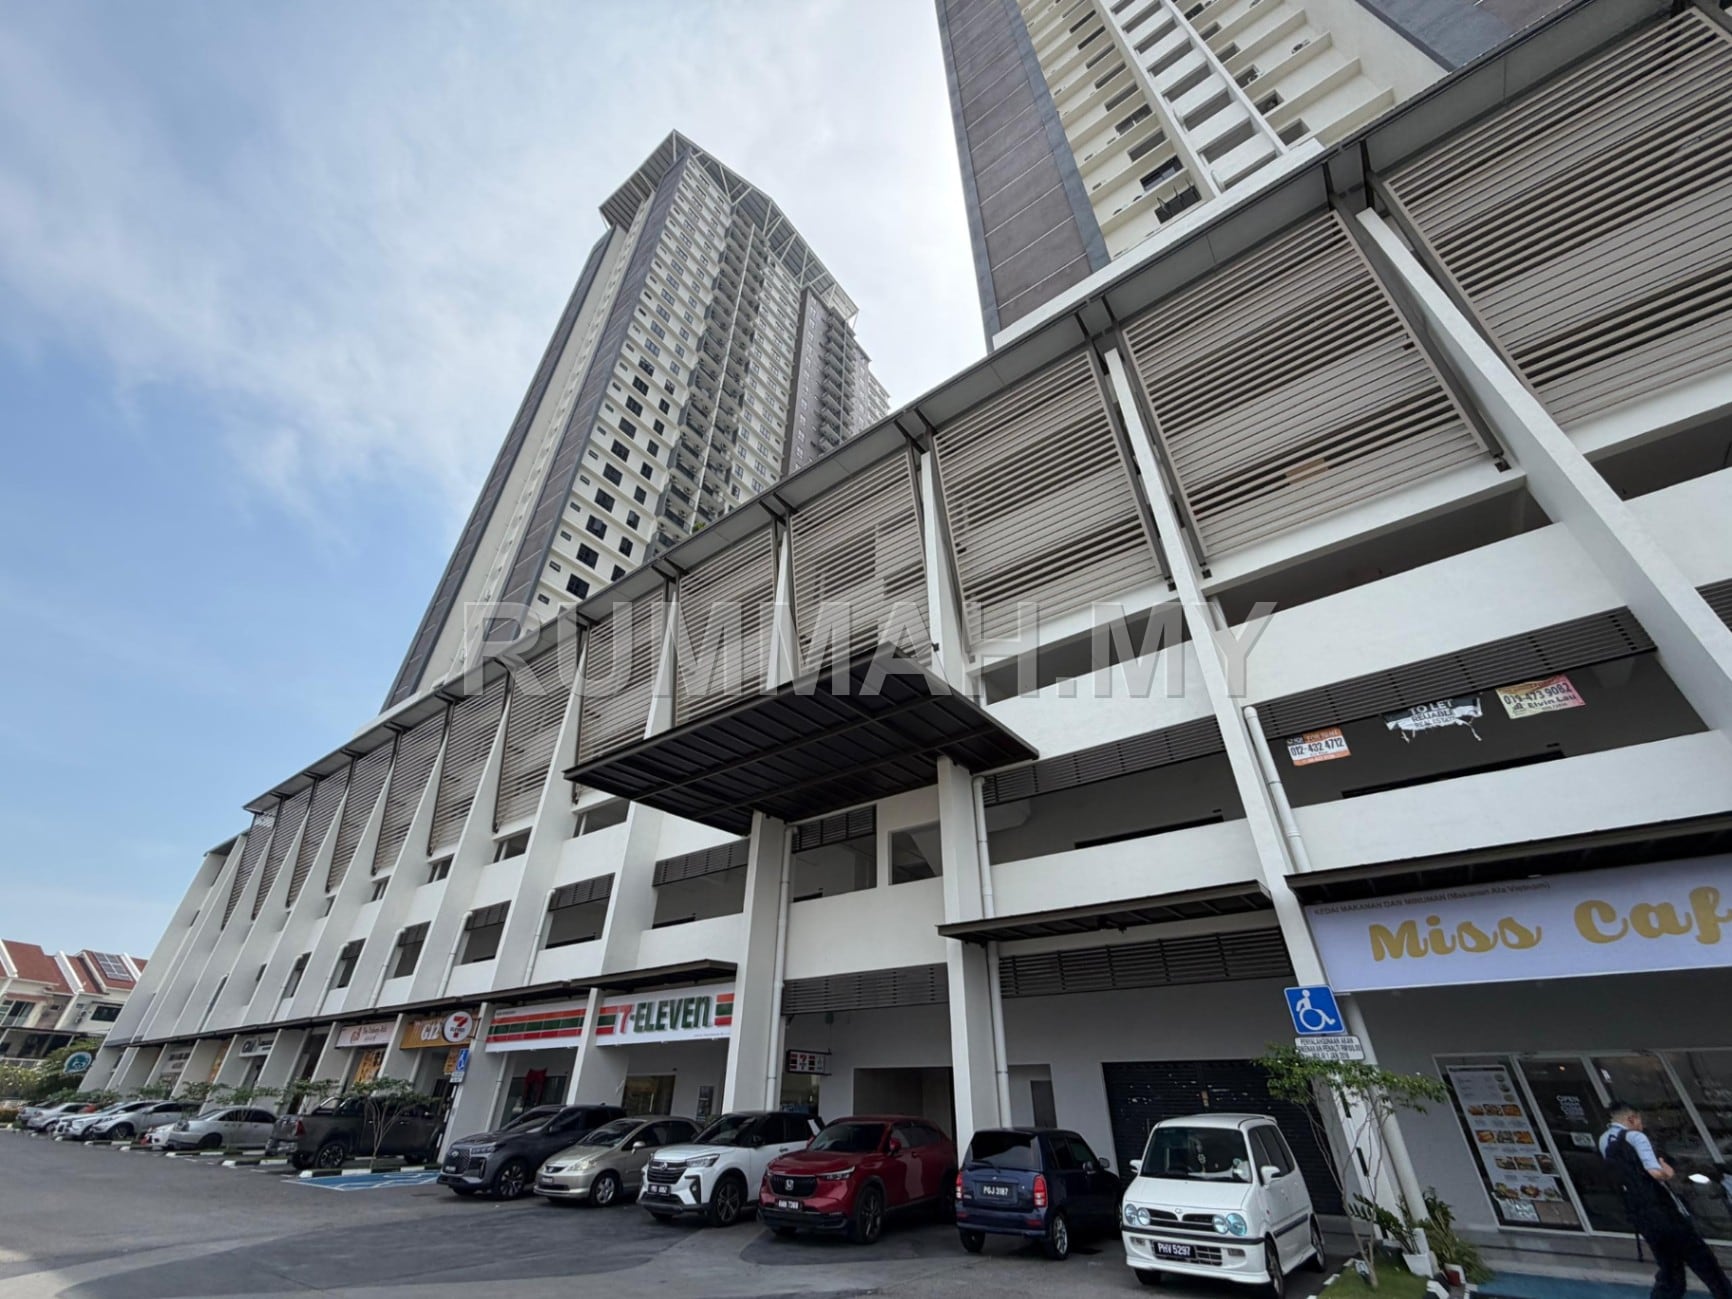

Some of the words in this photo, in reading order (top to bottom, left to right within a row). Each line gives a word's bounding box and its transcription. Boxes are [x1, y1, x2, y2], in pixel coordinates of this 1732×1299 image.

[1503, 691, 1545, 705] 019-473
[1545, 682, 1572, 697] 9082
[1408, 705, 1428, 715] TO
[1429, 699, 1453, 711] LET
[1290, 742, 1324, 757] 012-432
[1324, 737, 1345, 751] 4712
[1368, 914, 1542, 962] Miss
[983, 1185, 996, 1195] PGJ
[1157, 1242, 1172, 1255] PHV
[1172, 1244, 1191, 1257] 5297
